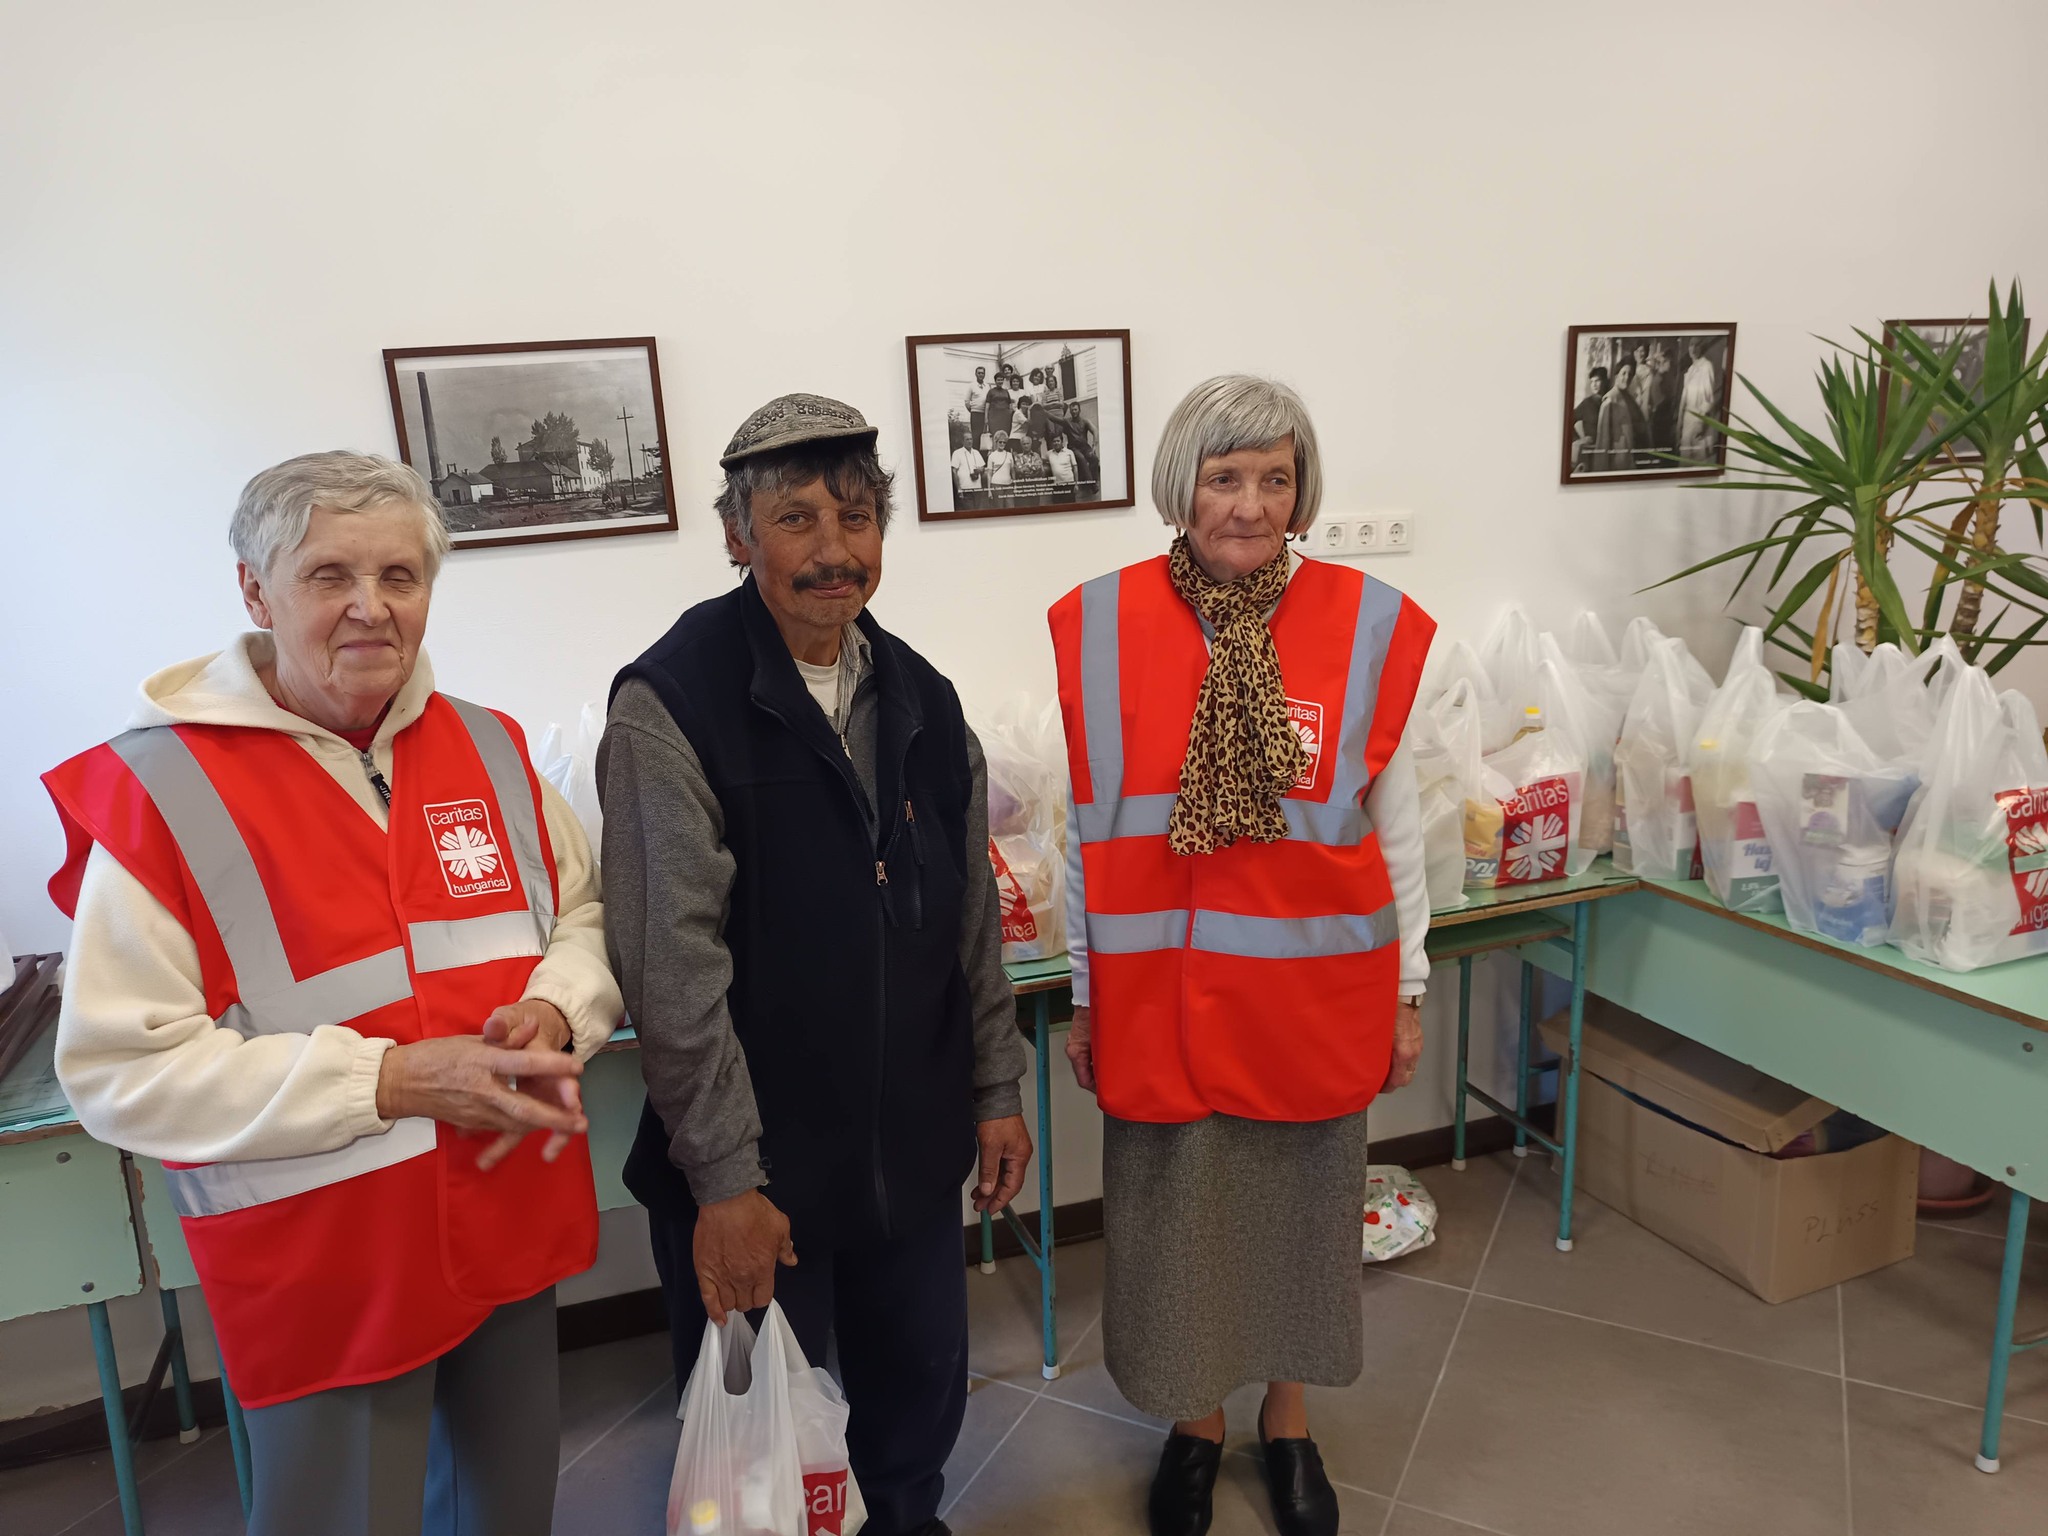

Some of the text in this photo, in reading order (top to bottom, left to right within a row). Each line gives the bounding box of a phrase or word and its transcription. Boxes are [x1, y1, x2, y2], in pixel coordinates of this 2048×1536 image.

[1287, 704, 1318, 722] ritas
[1504, 784, 1568, 817] caritas
[430, 807, 483, 825] caritas
[453, 878, 507, 894] hungarica
